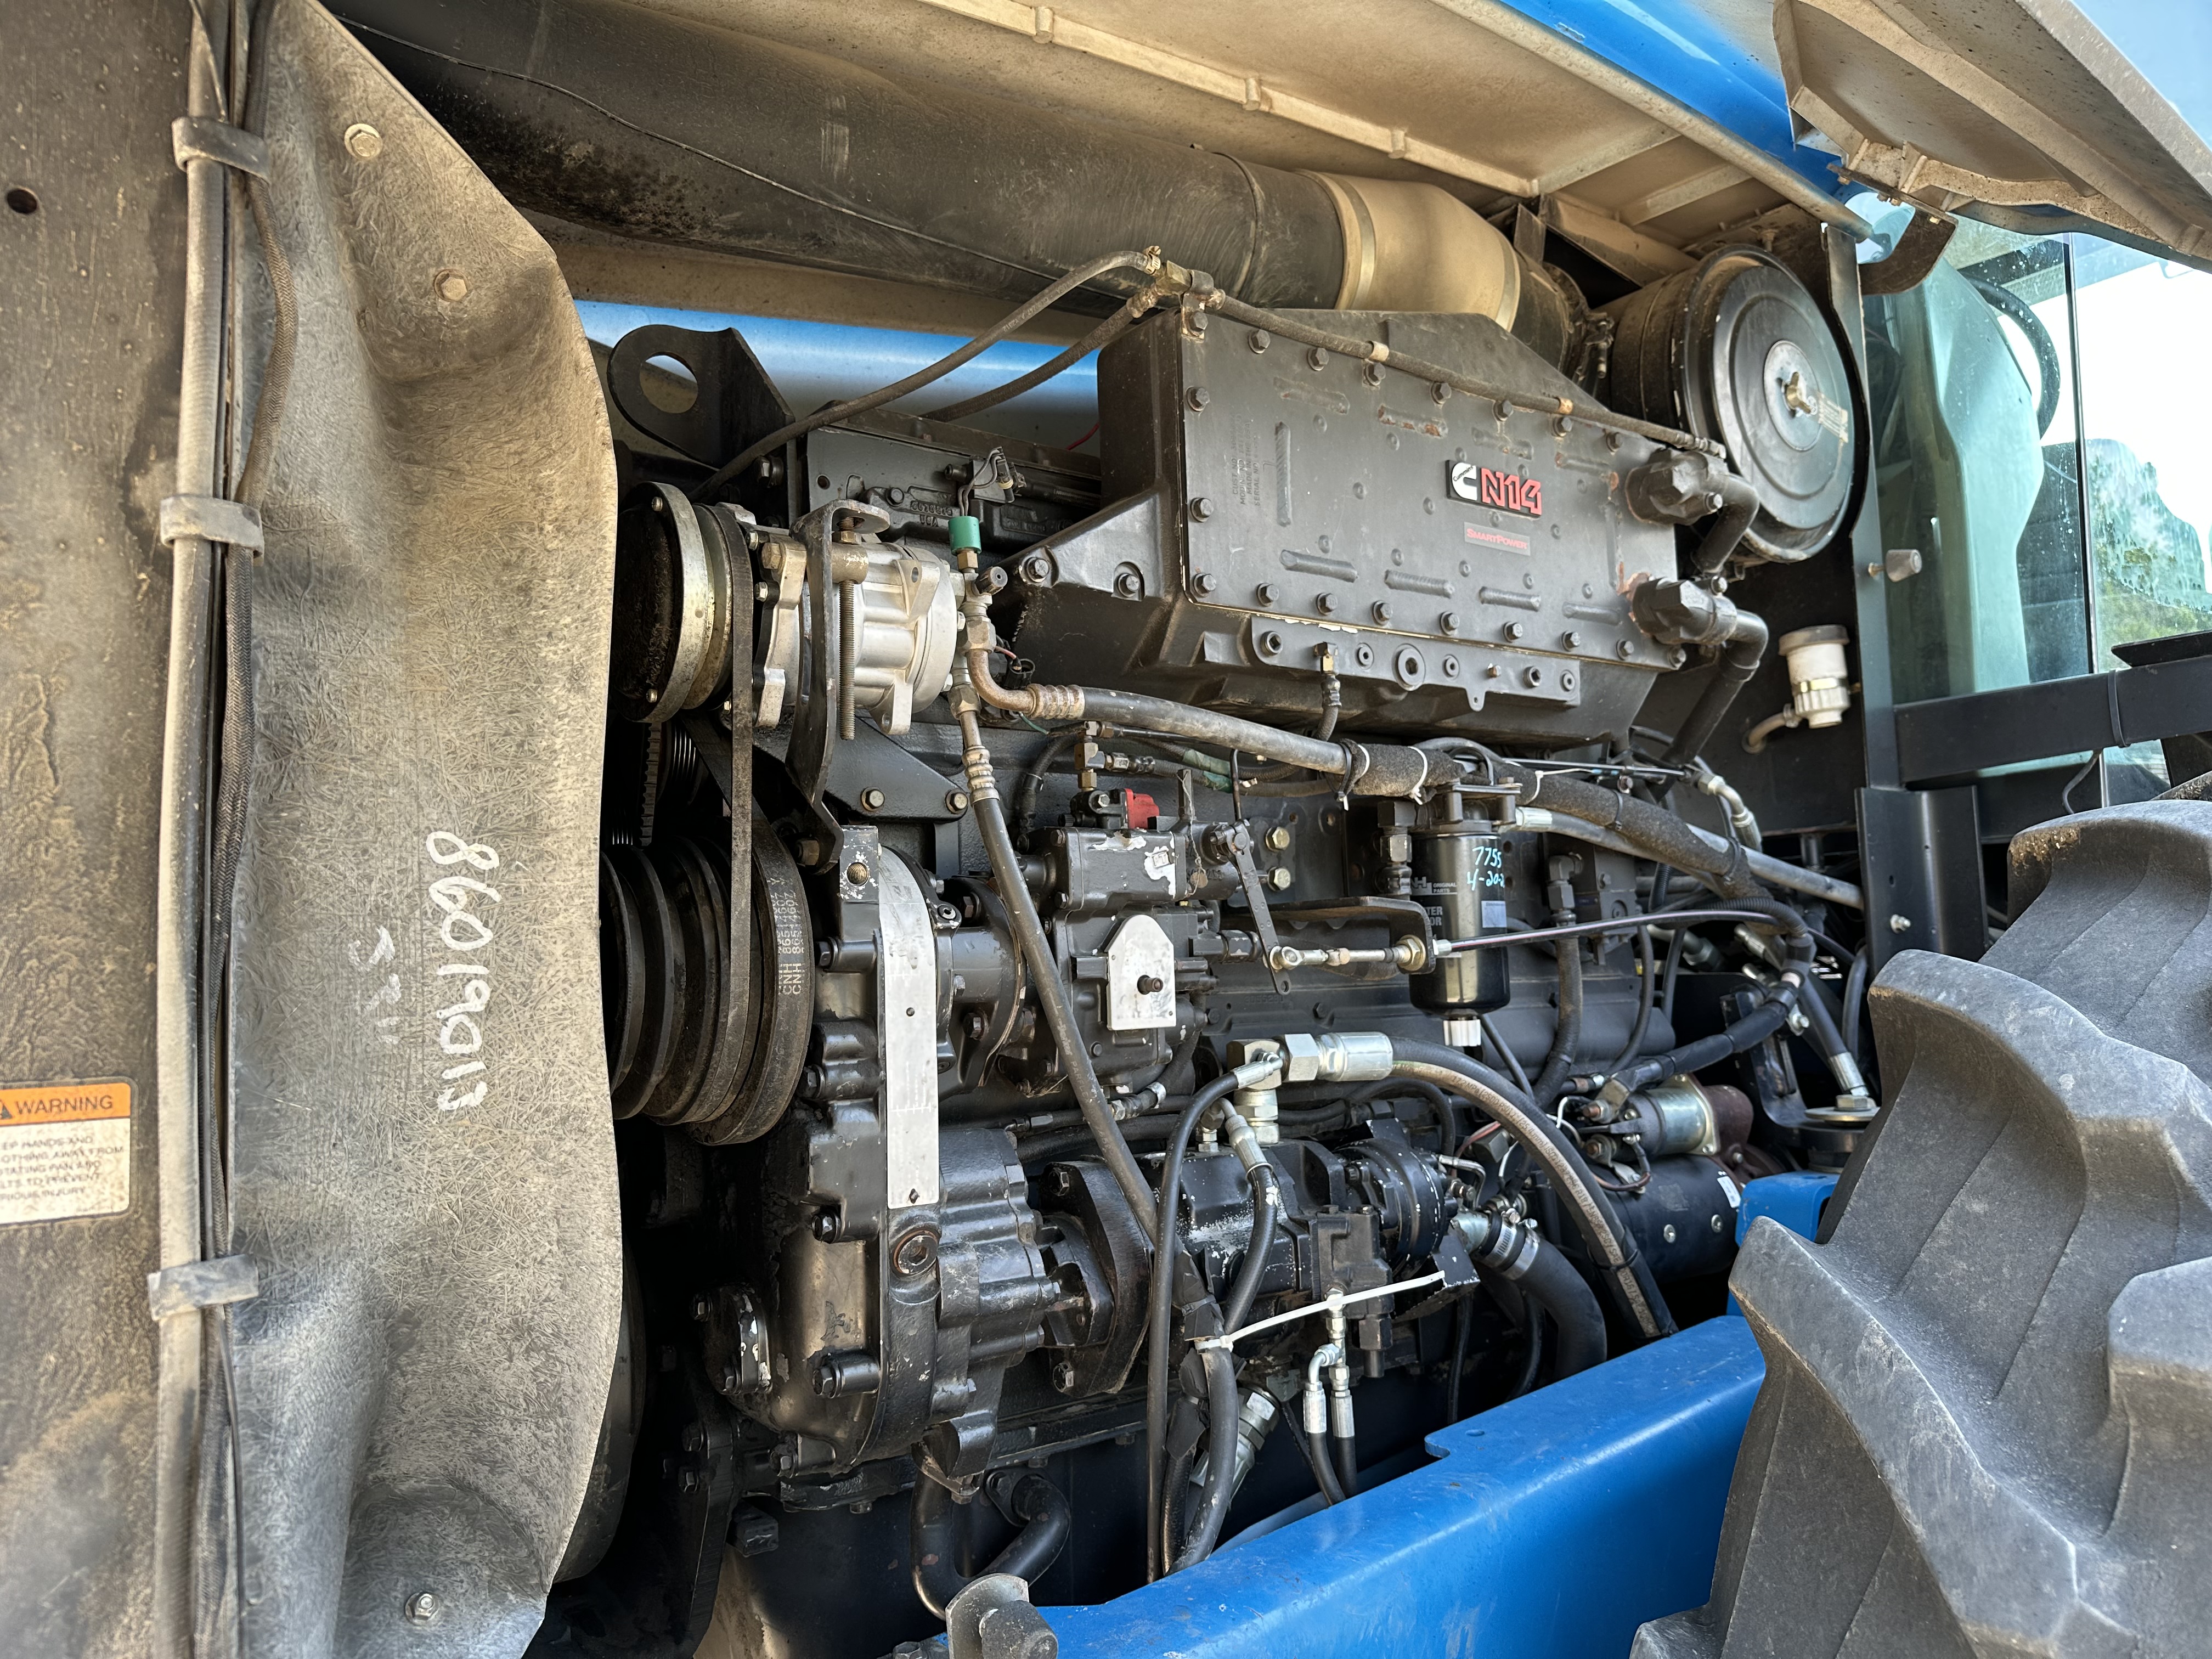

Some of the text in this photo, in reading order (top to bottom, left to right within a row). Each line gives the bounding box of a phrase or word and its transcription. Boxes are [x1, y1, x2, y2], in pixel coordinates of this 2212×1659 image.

[1453, 465, 1474, 482] Cummins
[1481, 467, 1542, 515] N14
[1472, 845, 1502, 868] 7755
[783, 963, 792, 995] CNH
[792, 963, 802, 995] CNH
[1070, 1060, 1093, 1104] PARFLEX
[15, 1094, 114, 1116] WARNING
[21, 1138, 63, 1149] HANDS
[1, 1152, 49, 1164] OTHING
[89, 1146, 123, 1155] FROM
[1609, 1248, 1621, 1263] SAE
